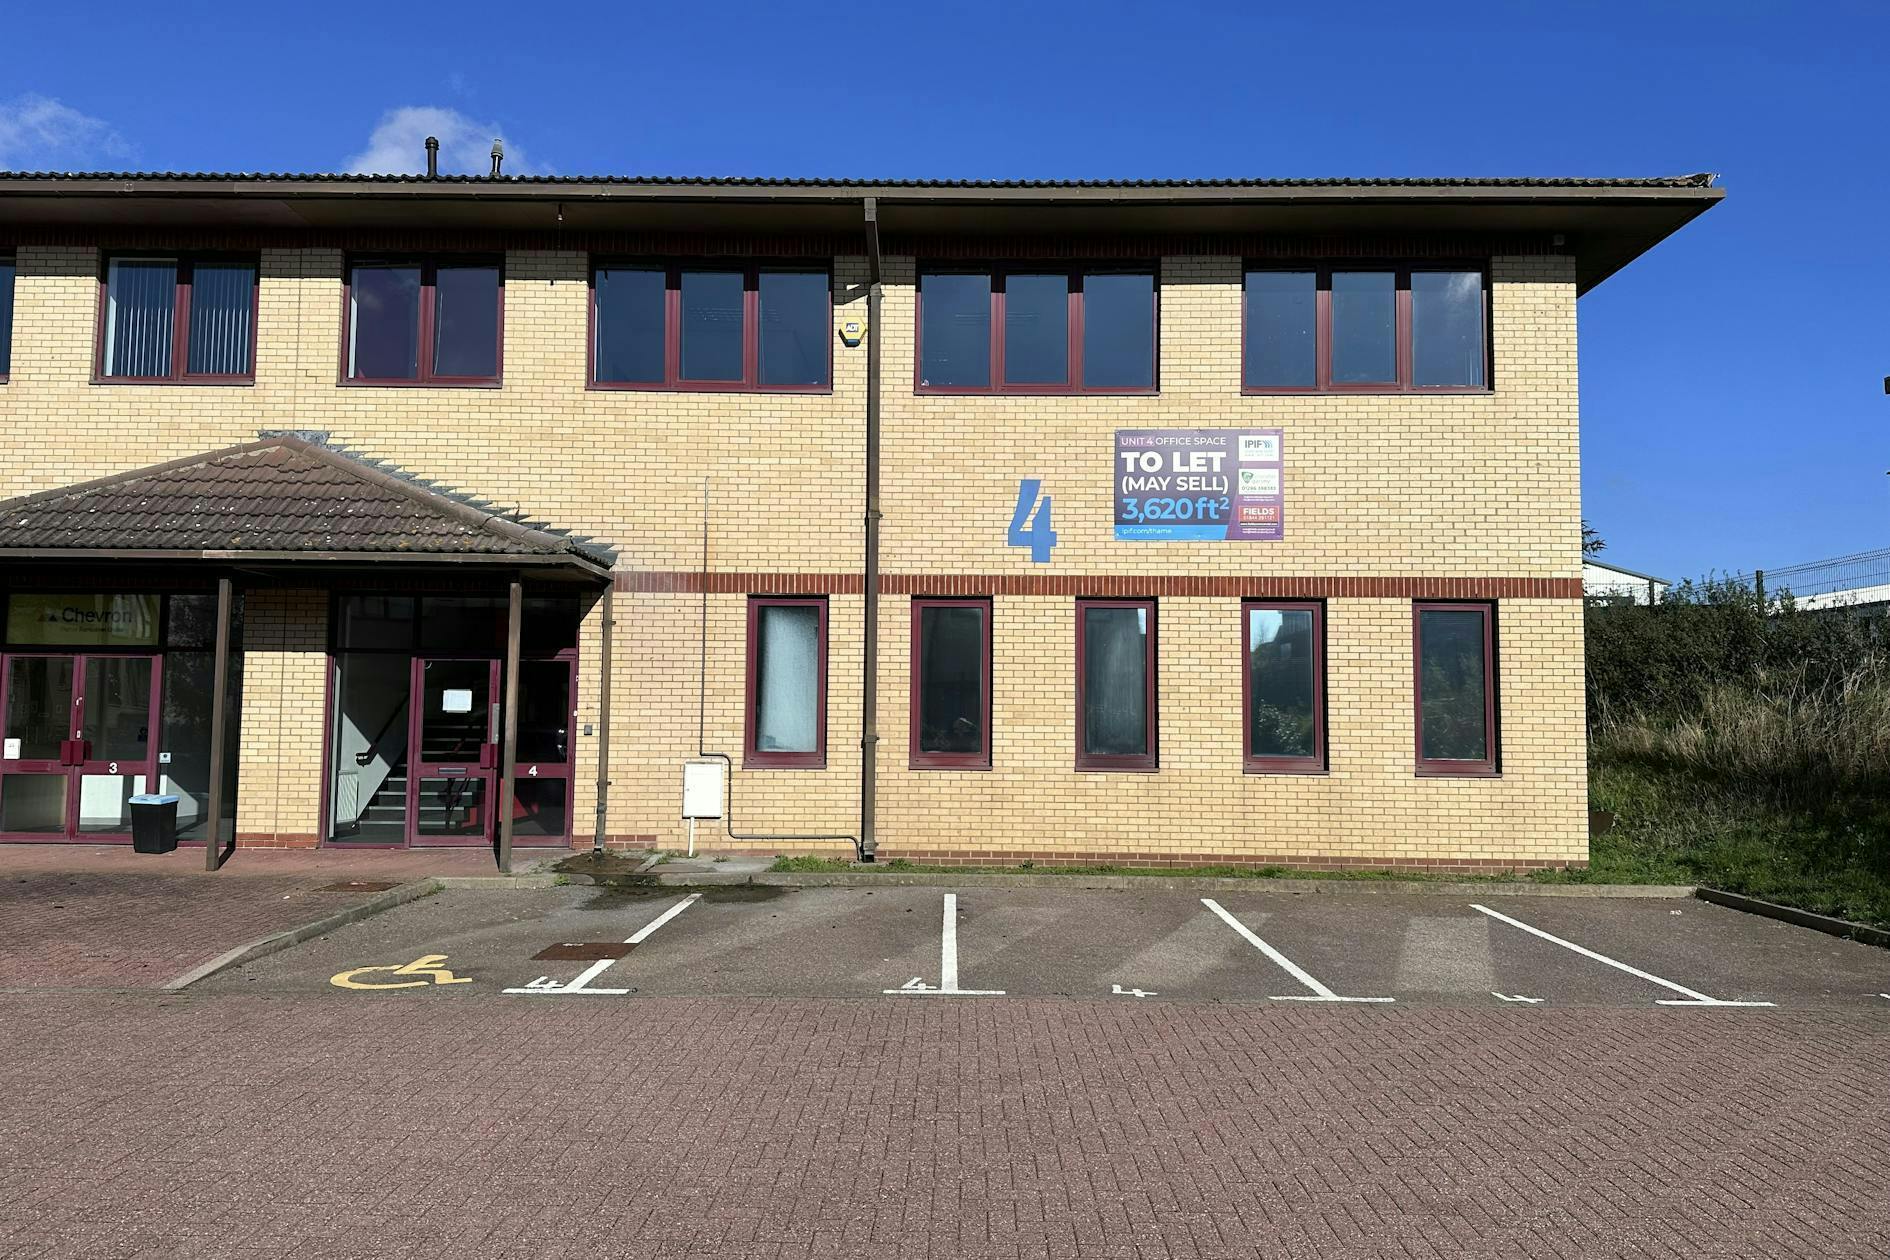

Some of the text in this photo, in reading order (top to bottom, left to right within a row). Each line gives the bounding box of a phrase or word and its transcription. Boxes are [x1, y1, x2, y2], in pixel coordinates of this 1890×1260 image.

[846, 324, 859, 332] ADT
[1121, 437, 1227, 446] UNIT 4 OFFICE SPACE
[1244, 439, 1263, 449] IPIF
[1120, 451, 1227, 473] TO LET
[1122, 476, 1229, 494] (MAY SELL)
[1243, 507, 1275, 515] FIELDS
[1007, 479, 1057, 563] 4
[62, 607, 132, 623] Chevron
[109, 762, 118, 774] 3
[528, 765, 538, 777] 4
